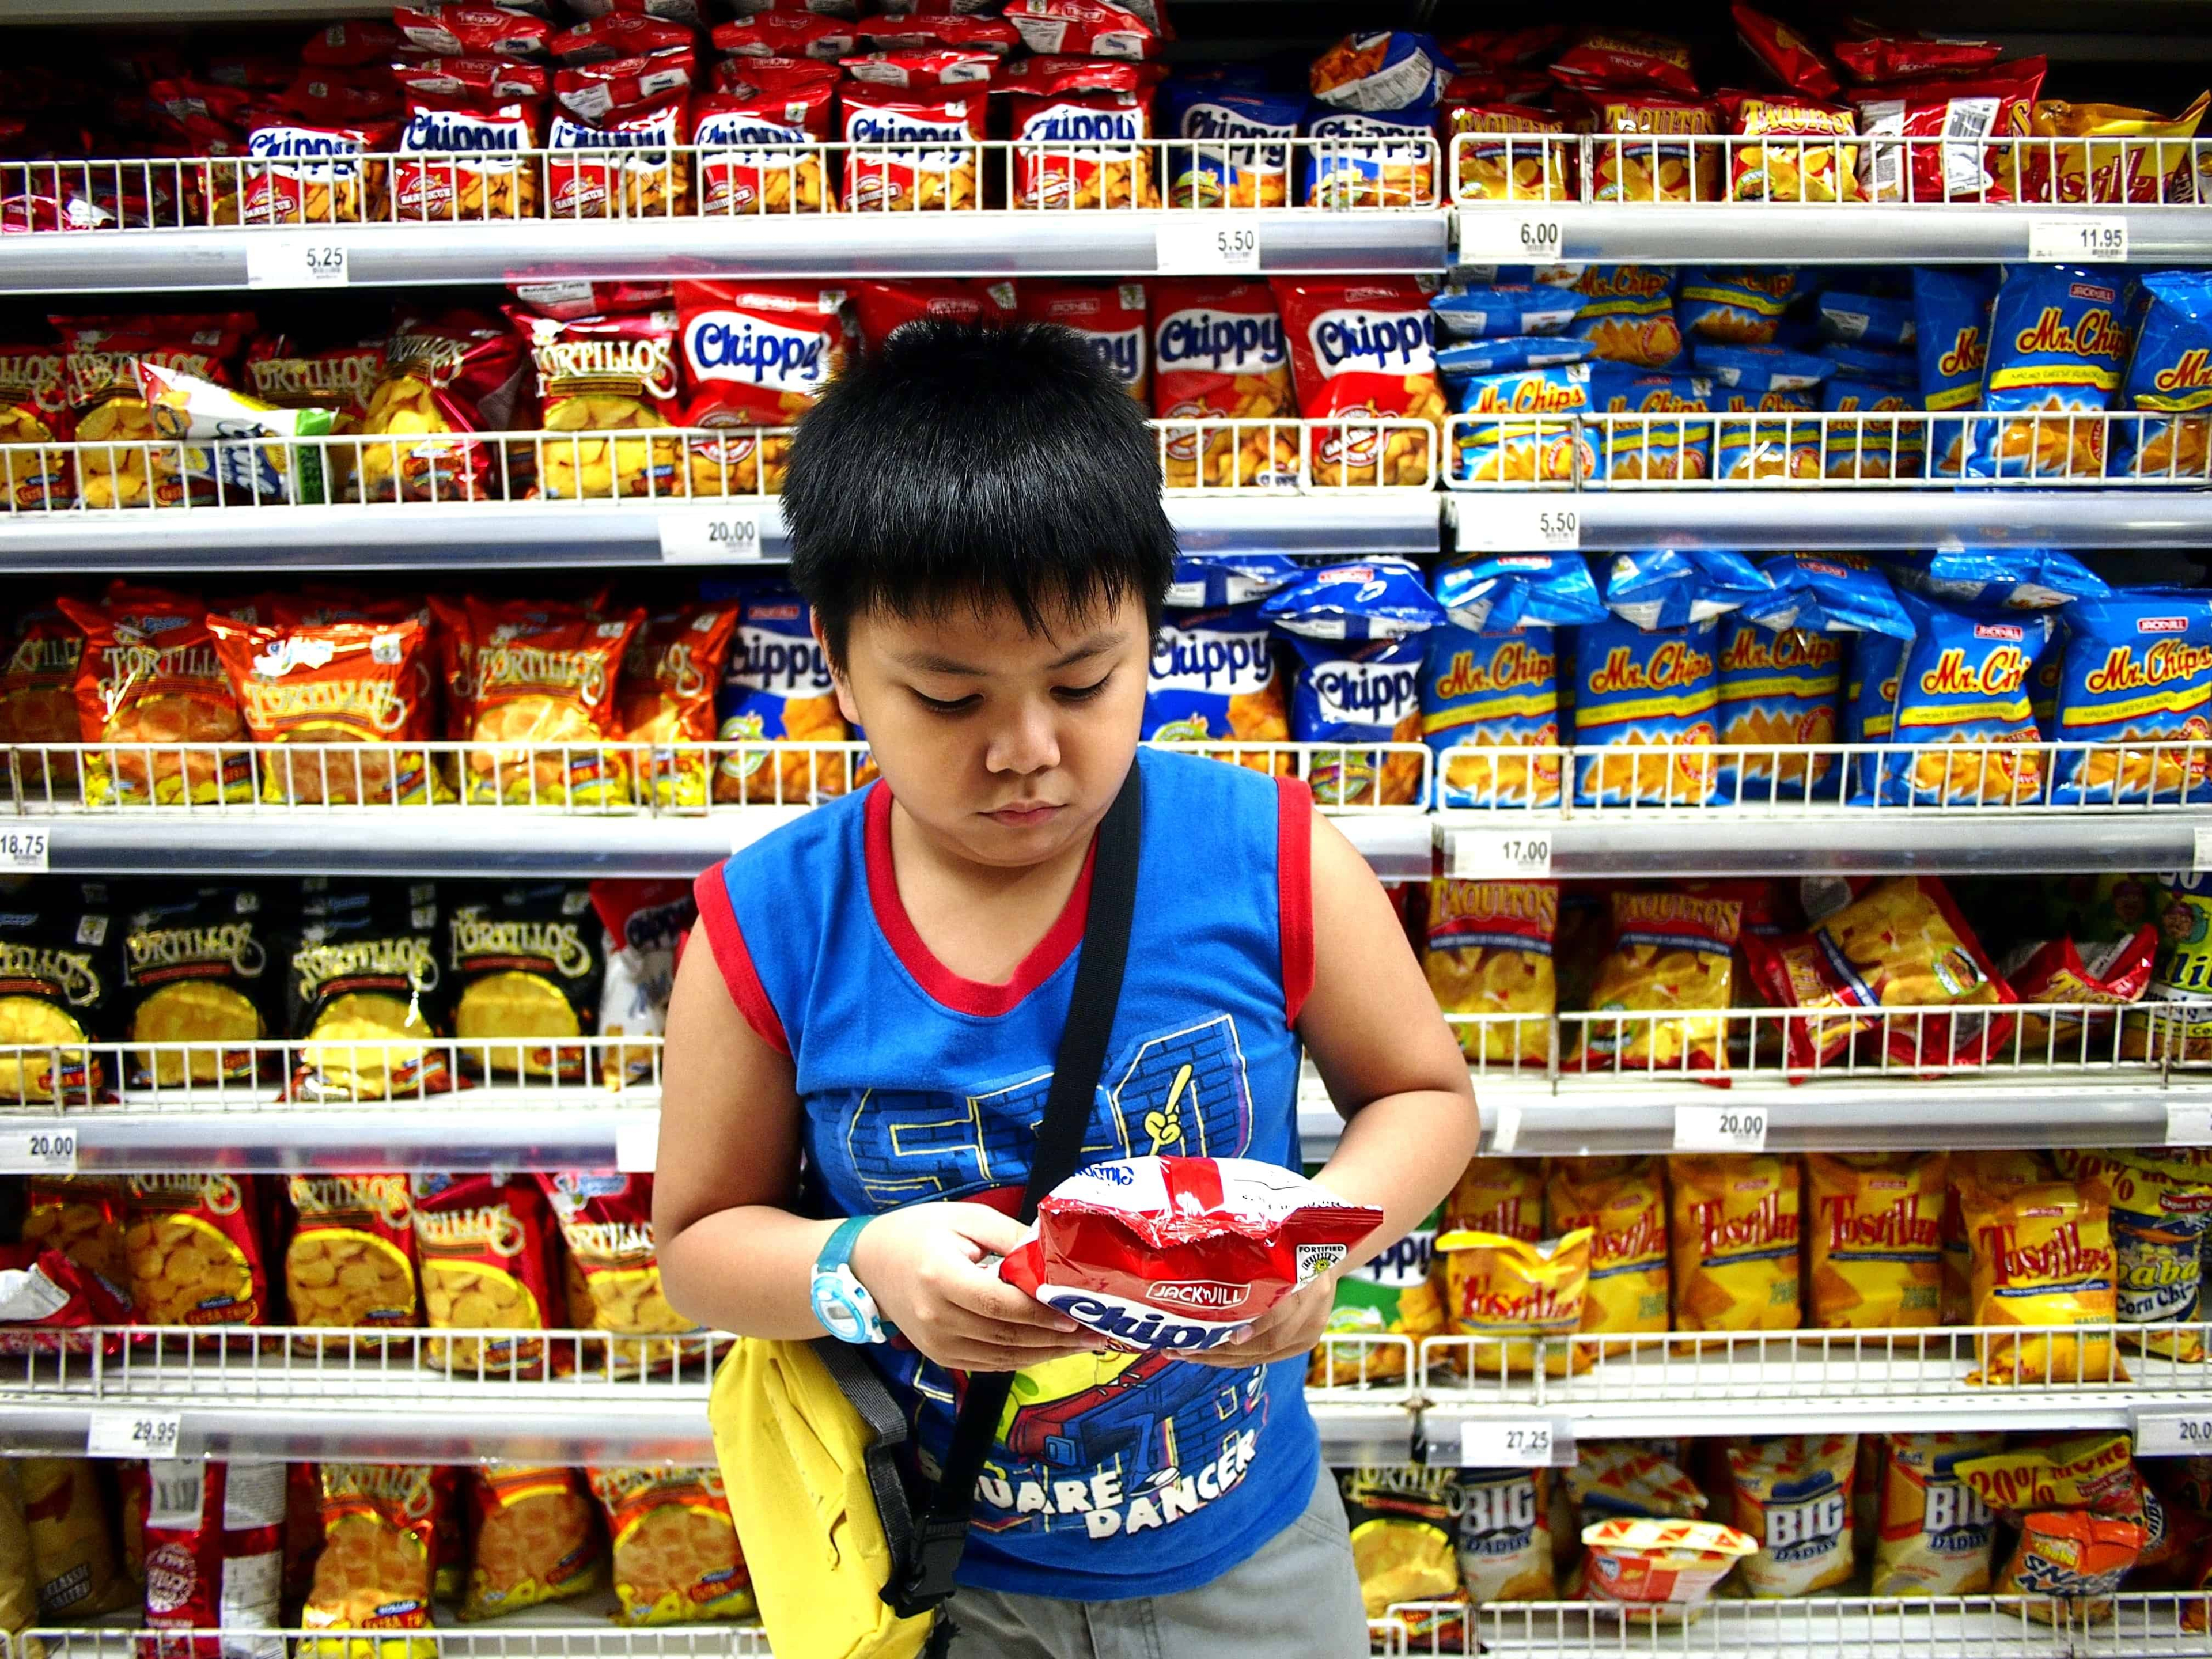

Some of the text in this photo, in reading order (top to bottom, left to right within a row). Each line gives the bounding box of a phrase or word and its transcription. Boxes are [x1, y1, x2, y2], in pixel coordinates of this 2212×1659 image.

[1188, 107, 1291, 167] Chippy
[1316, 119, 1427, 160] Chippy
[1218, 230, 1255, 251] 5.50
[1520, 223, 1558, 244] 6.00
[2081, 229, 2123, 248] 11.95
[306, 247, 343, 268] 5.25
[695, 323, 824, 382] Chippy
[1160, 314, 1285, 369] Chippy
[2017, 306, 2074, 354] Mr.
[1469, 377, 1587, 415] Mr. Chips
[709, 521, 755, 541] 20.00
[1540, 512, 1577, 532] 5.50
[474, 641, 611, 706] TORTILLOS
[1150, 632, 1272, 688] Chippy
[1589, 642, 1713, 694] Mr. Chips
[1718, 630, 1772, 670] Mr.
[1921, 648, 1979, 695] Mr.
[2086, 638, 2211, 694] Mr. Chips
[1317, 668, 1420, 721] Chipp
[1437, 652, 1491, 699] Mr.
[244, 680, 407, 732] TORTILLOS
[1, 835, 44, 855] 18.75
[1502, 841, 1548, 861] 17.00
[1428, 877, 1556, 934] TAQUITOS
[1613, 892, 1743, 941] TAQUITOS
[293, 938, 439, 1003] TORTILLOS
[450, 920, 592, 978] TORTILLOS
[30, 1137, 73, 1156] 20.00
[1719, 1113, 1763, 1135] 20.00
[132, 1422, 176, 1441] 29.95
[1085, 1428, 1257, 1540] DANCER
[1969, 1467, 2055, 1505] 20%
[1460, 1482, 1536, 1535] BIG
[1766, 1493, 1844, 1548] BIG
[1774, 1537, 1838, 1562] DADDY
